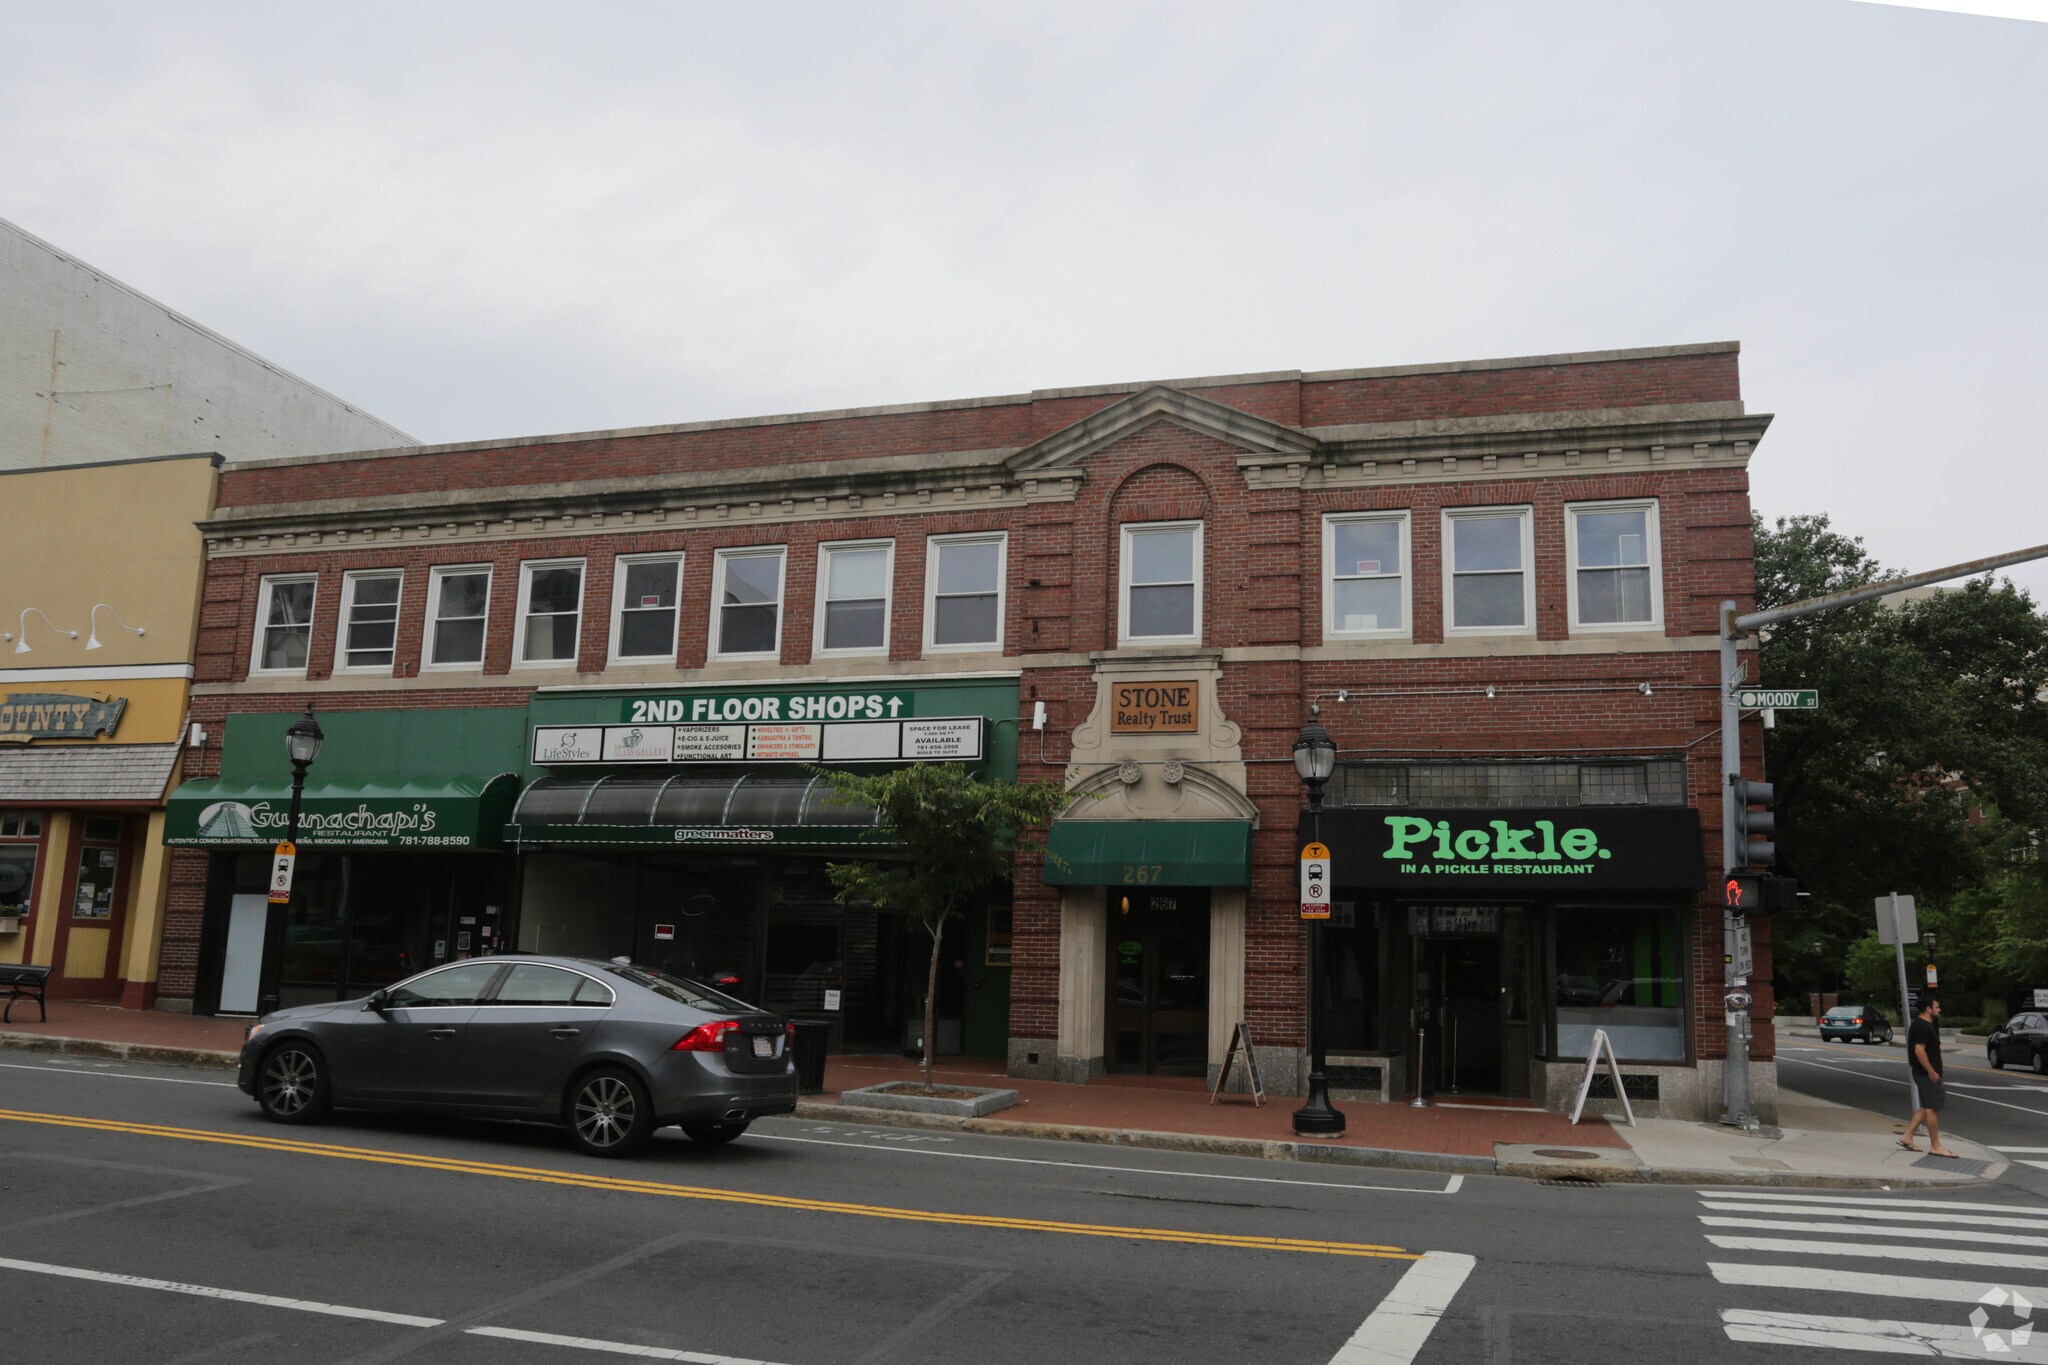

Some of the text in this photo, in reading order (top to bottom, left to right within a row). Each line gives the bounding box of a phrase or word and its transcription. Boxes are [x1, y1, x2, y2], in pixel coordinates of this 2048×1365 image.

[1119, 688, 1190, 707] STONE
[1757, 692, 1815, 706] MOODY ST
[631, 695, 883, 722] 2ND FLOOR SHOPS
[1117, 710, 1192, 729] Realty Trust
[544, 747, 590, 760] LifeStyles
[636, 747, 667, 757] GALLERY
[400, 836, 469, 845] 781-788-8590
[675, 828, 774, 841] greenmatters
[1383, 816, 1611, 860] Pickle.
[1311, 847, 1320, 855] T
[1123, 866, 1162, 884] 267
[1401, 864, 1594, 874] IN A PICKLE RESTAURANT
[1151, 897, 1176, 910] 267
